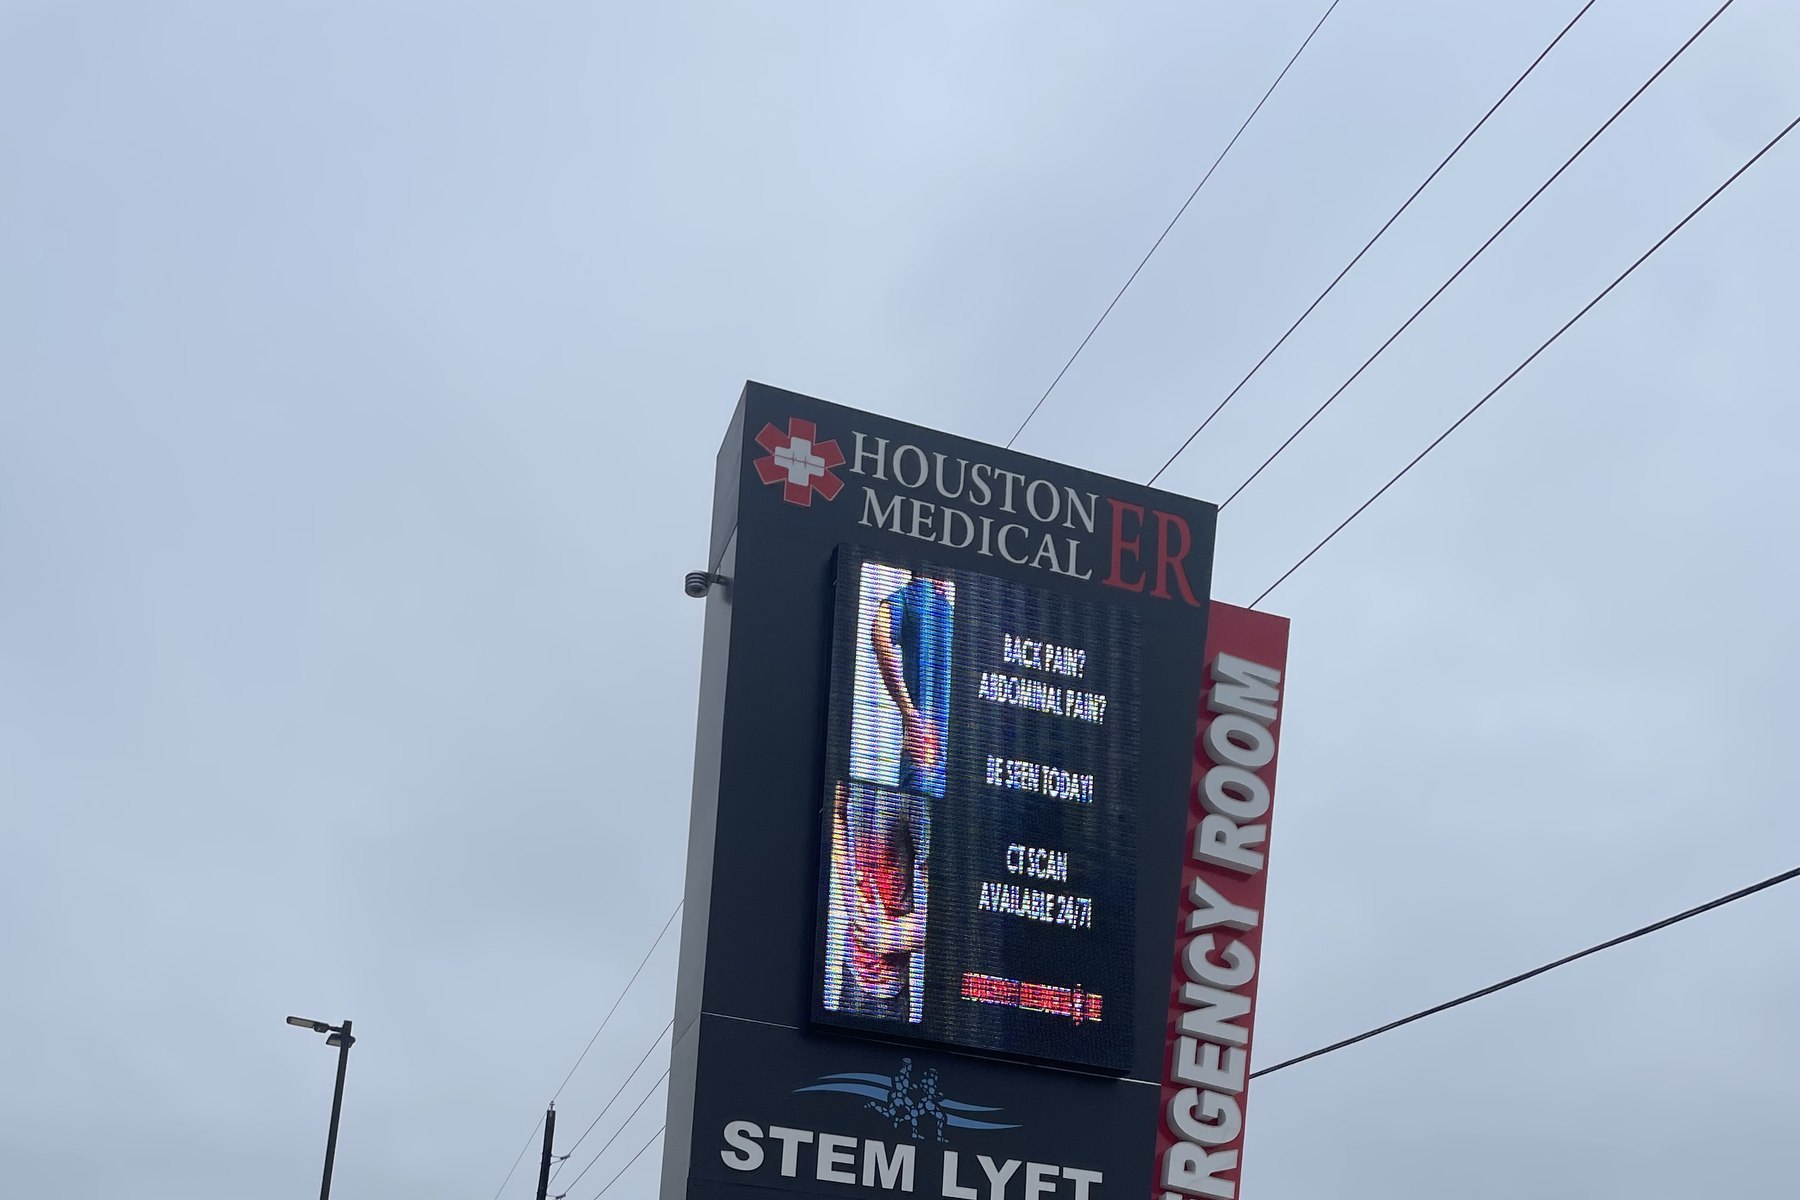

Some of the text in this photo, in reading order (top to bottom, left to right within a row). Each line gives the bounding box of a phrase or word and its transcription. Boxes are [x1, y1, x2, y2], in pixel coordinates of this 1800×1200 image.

[849, 431, 1097, 534] HOUSTON
[857, 487, 1093, 581] MEDICAL
[1101, 498, 1201, 607] ER
[1003, 632, 1043, 671] BACK
[978, 671, 1064, 715] ABDOMINAL
[986, 754, 1004, 786] BE
[1193, 651, 1282, 876] ROOM
[1006, 842, 1068, 883] CT SCAN
[977, 881, 1055, 923] AVAILABLE
[720, 1120, 916, 1193] STEM
